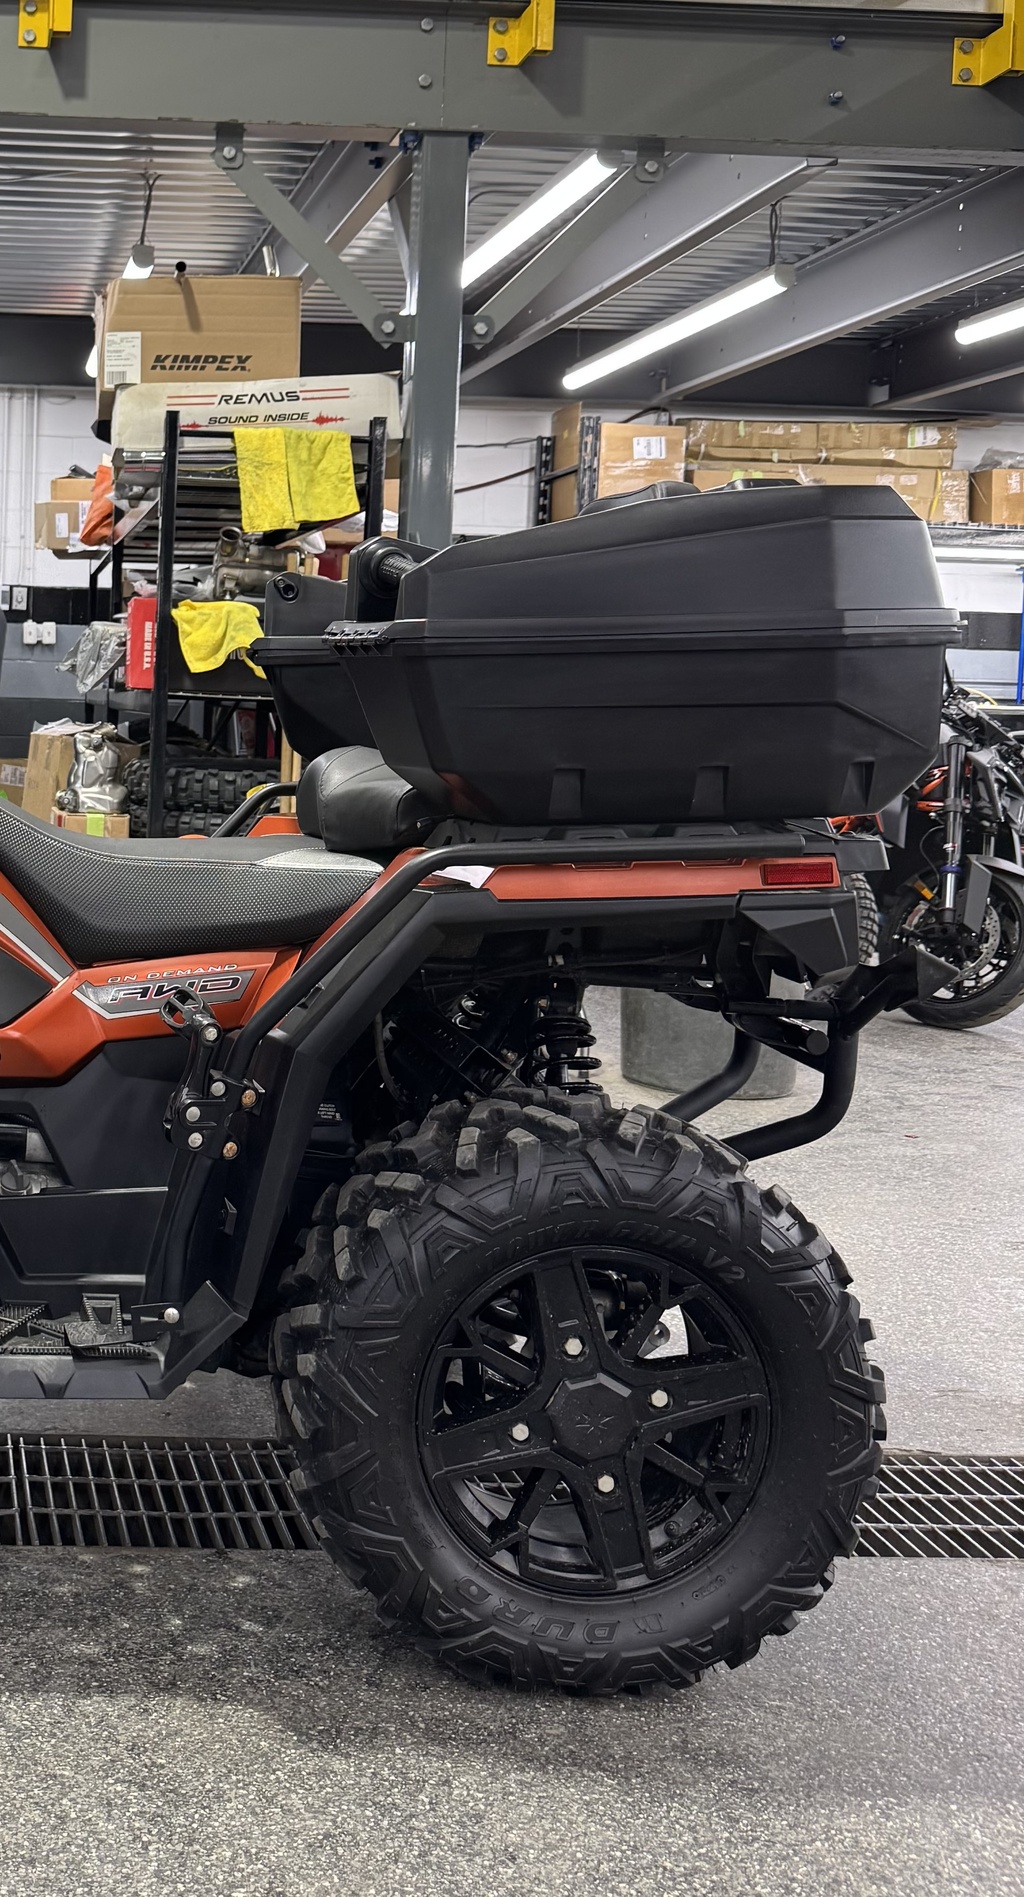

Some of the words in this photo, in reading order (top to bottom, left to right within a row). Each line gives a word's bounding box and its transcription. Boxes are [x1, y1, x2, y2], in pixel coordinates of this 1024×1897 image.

[150, 354, 253, 372] KIMPEX
[215, 391, 301, 408] REMUS
[207, 414, 259, 425] SOUND
[263, 411, 310, 422] INSIDE
[145, 621, 153, 641] MADE
[107, 974, 138, 984] ON
[146, 963, 239, 979] DEMAND
[107, 975, 243, 1004] AWD
[702, 1245, 747, 1286] V2
[456, 1574, 621, 1645] DURO
